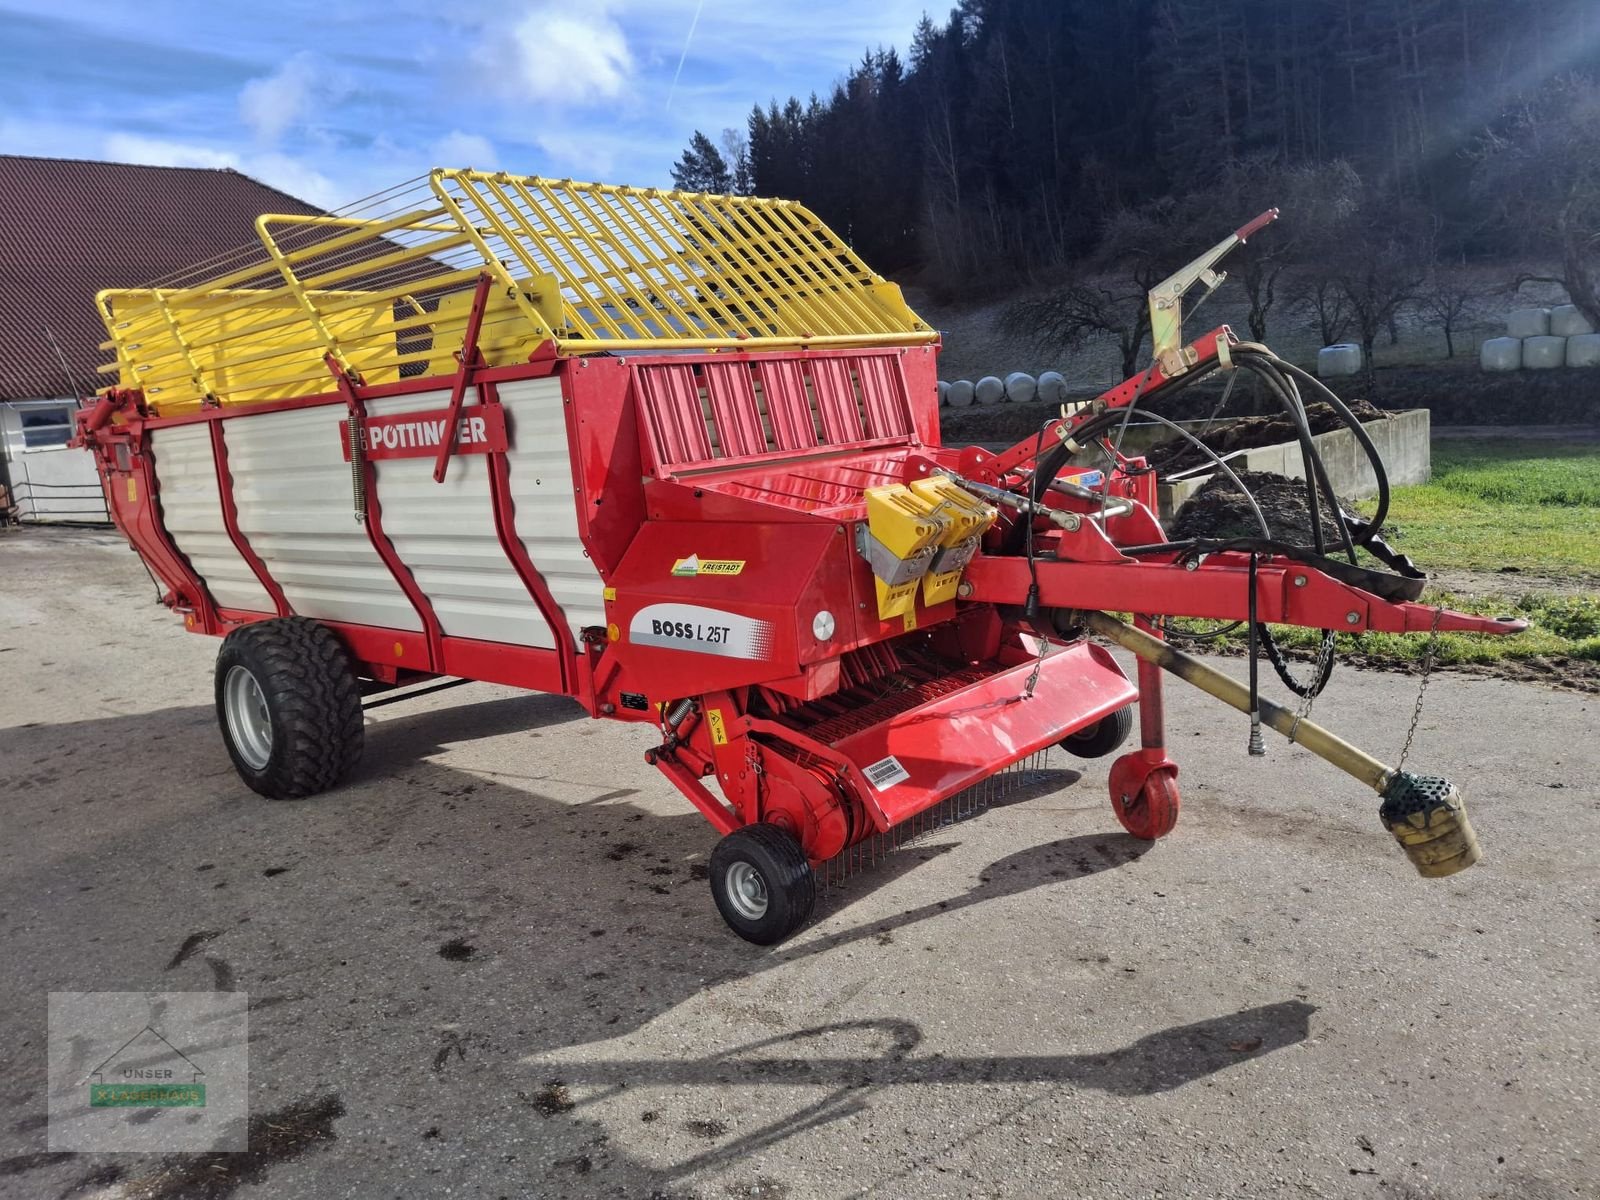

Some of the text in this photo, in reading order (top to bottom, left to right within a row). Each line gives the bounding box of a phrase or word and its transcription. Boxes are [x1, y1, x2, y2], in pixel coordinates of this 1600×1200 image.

[702, 563, 740, 571] FREISTADT
[652, 619, 730, 643] BOSS L 25T
